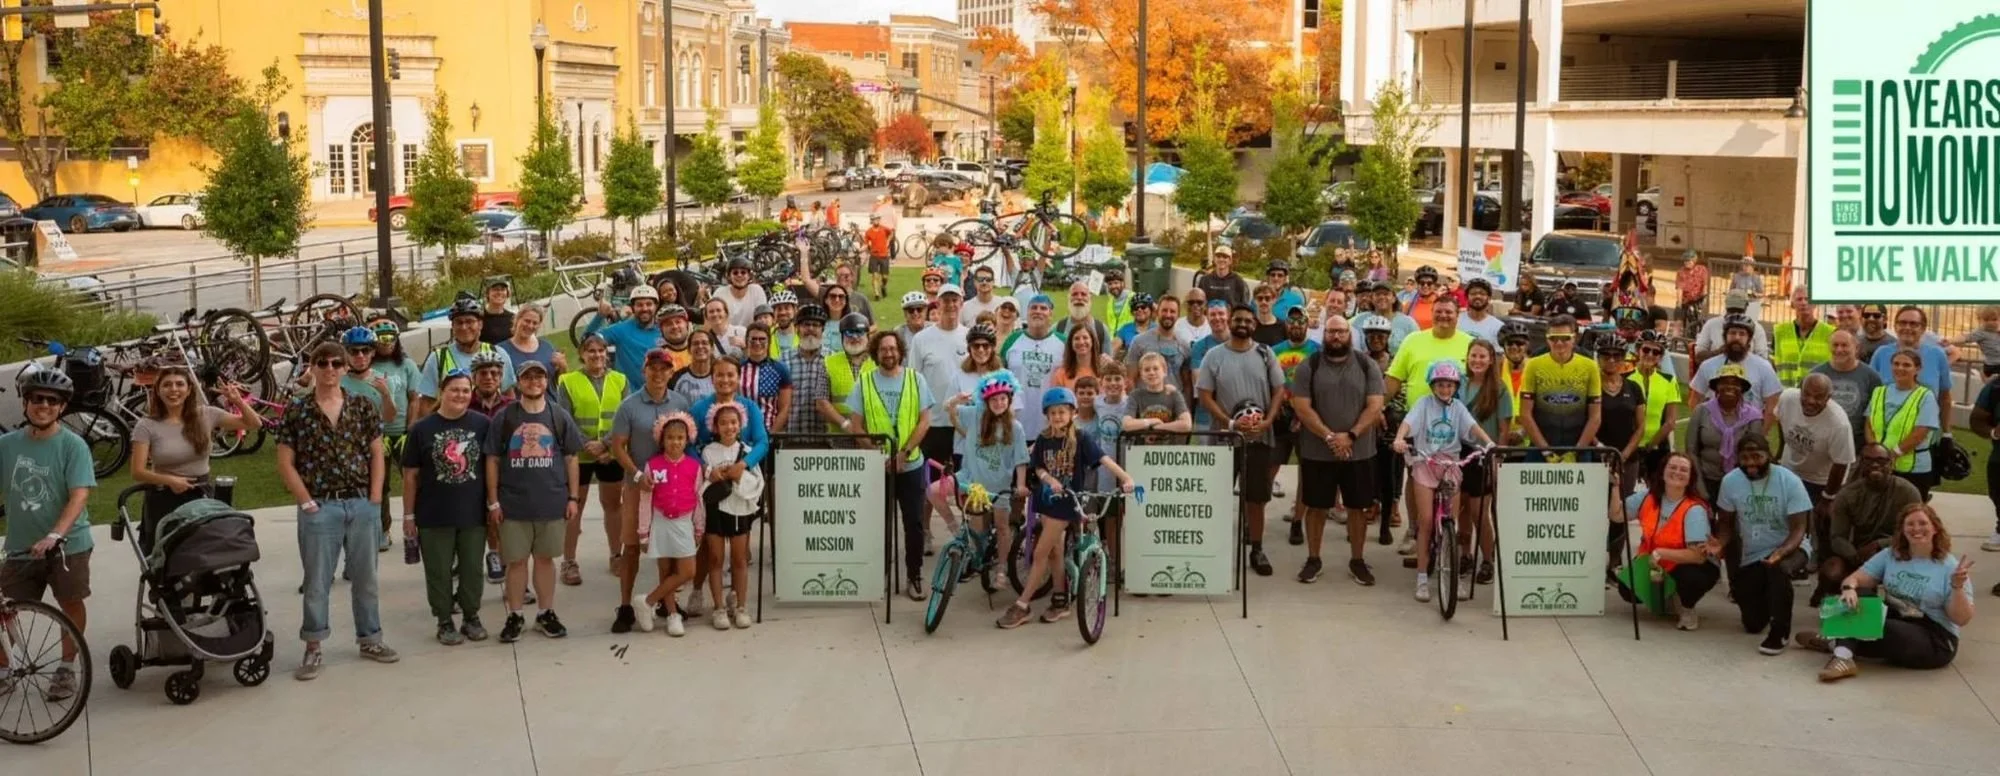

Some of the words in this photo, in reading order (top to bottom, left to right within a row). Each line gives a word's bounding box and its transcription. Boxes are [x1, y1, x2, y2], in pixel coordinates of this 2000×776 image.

[511, 457, 525, 468] CAT
[528, 457, 553, 468] DADDY
[793, 456, 865, 471] SUPPORTING
[1144, 451, 1215, 466] ADVOCATING
[652, 469, 668, 483] M
[1520, 469, 1574, 484] BUILDING
[1577, 470, 1585, 484] A
[798, 483, 825, 498] BIKE
[828, 483, 861, 498] WALK
[1150, 477, 1173, 492] FOR
[1175, 478, 1207, 494] SAFE,
[1145, 503, 1213, 519] CONNECTED
[1524, 497, 1579, 512] THRIVING
[803, 510, 856, 525] MACON'S
[1153, 530, 1204, 545] STREETS
[1527, 524, 1575, 539] BICYCLE
[805, 537, 854, 551] MISSION
[1515, 550, 1586, 566] COMMUNITY
